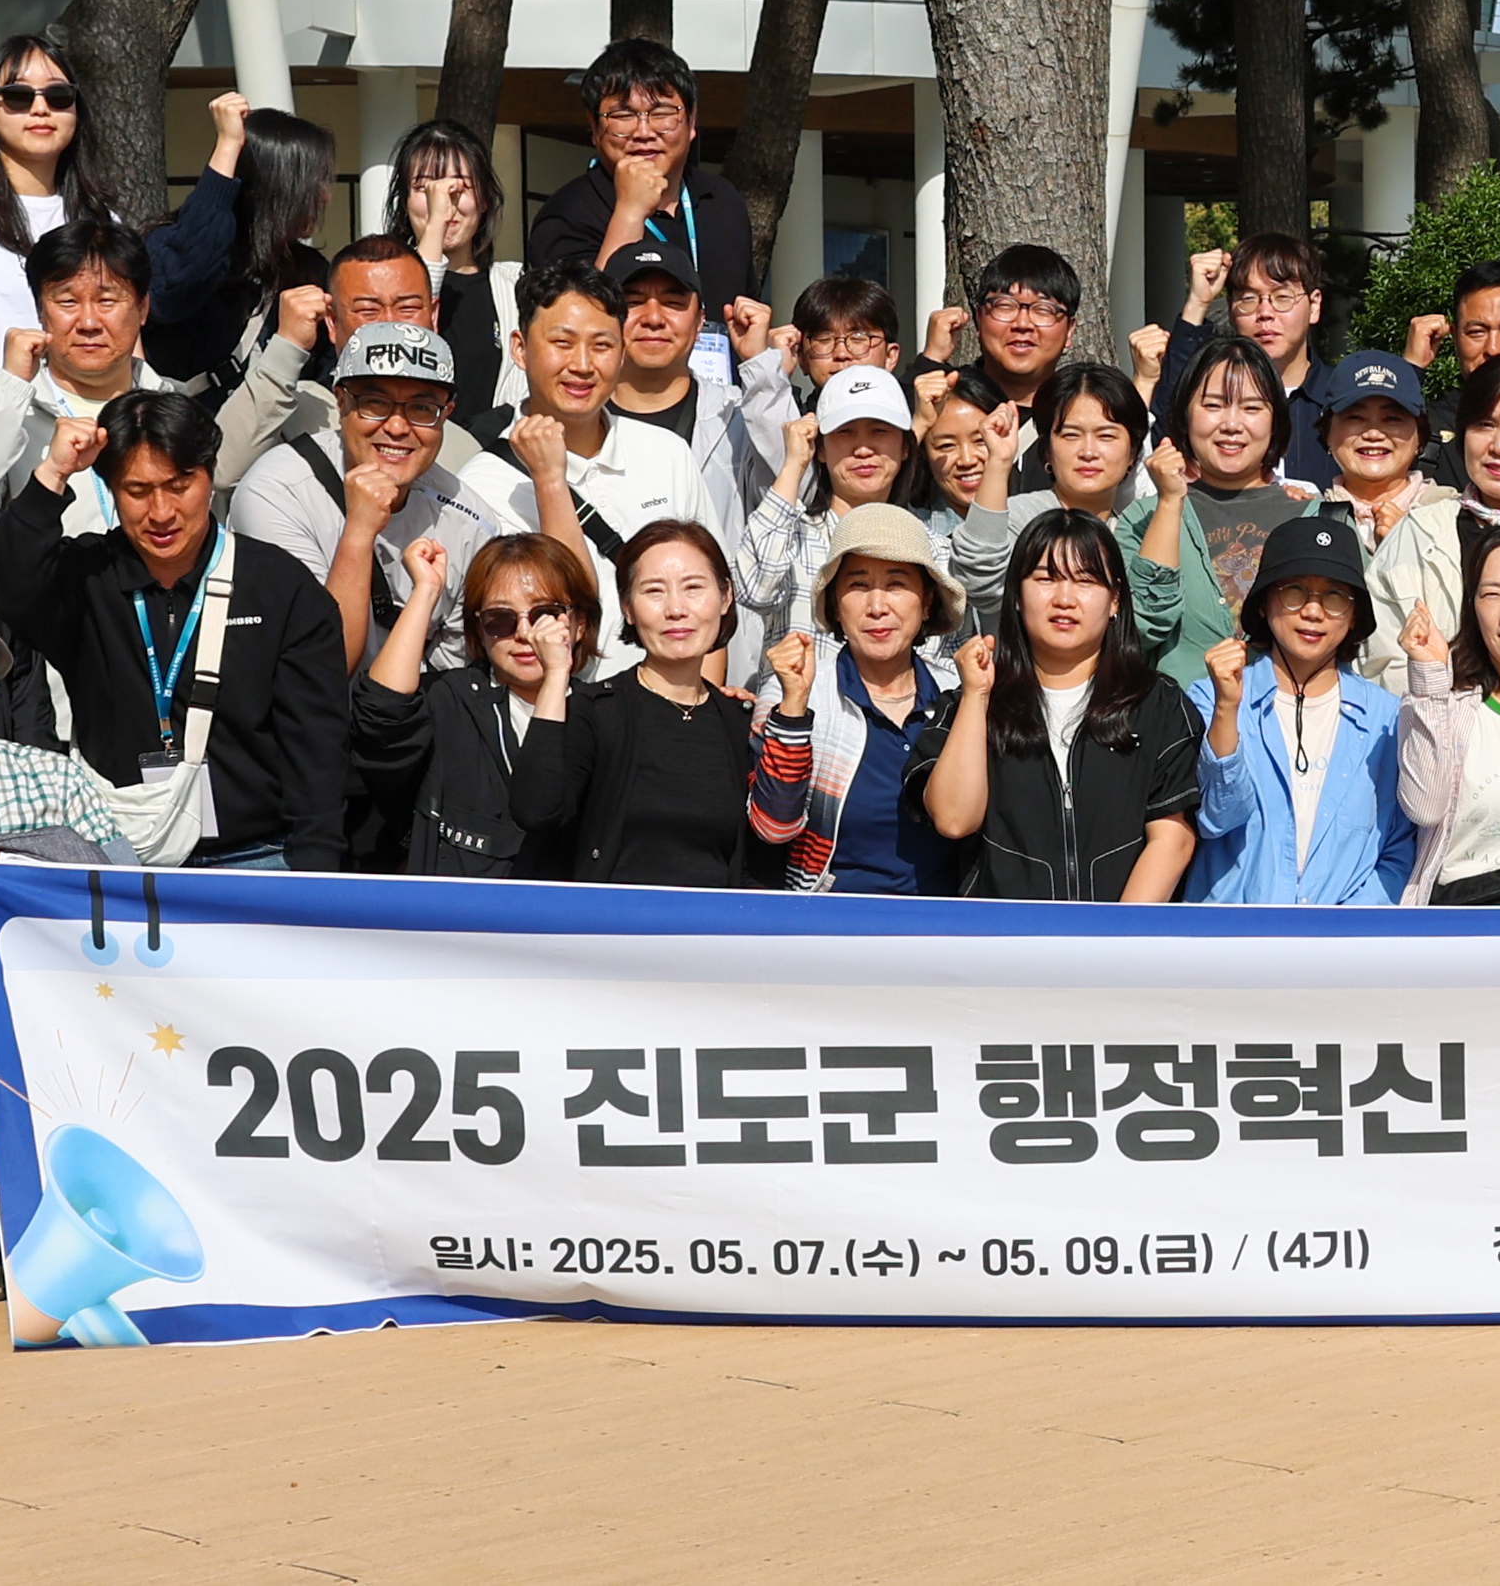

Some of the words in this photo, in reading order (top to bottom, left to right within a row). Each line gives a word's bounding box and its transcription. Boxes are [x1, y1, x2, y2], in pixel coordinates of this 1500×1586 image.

[365, 343, 439, 372] PING
[437, 494, 480, 521] UMBRO
[641, 497, 668, 510] umbro
[207, 1047, 525, 1165] 2025
[564, 1046, 937, 1166] 진도군
[976, 1043, 1467, 1164] 행정혁신
[430, 1237, 533, 1272] 일시:
[550, 1238, 674, 1275] 2025.
[690, 1239, 756, 1275] 05.
[774, 1239, 920, 1277] 07.(수)
[983, 1239, 1048, 1275] 05.
[1066, 1234, 1213, 1276] 09.(금)
[1268, 1230, 1369, 1272] (4기)
